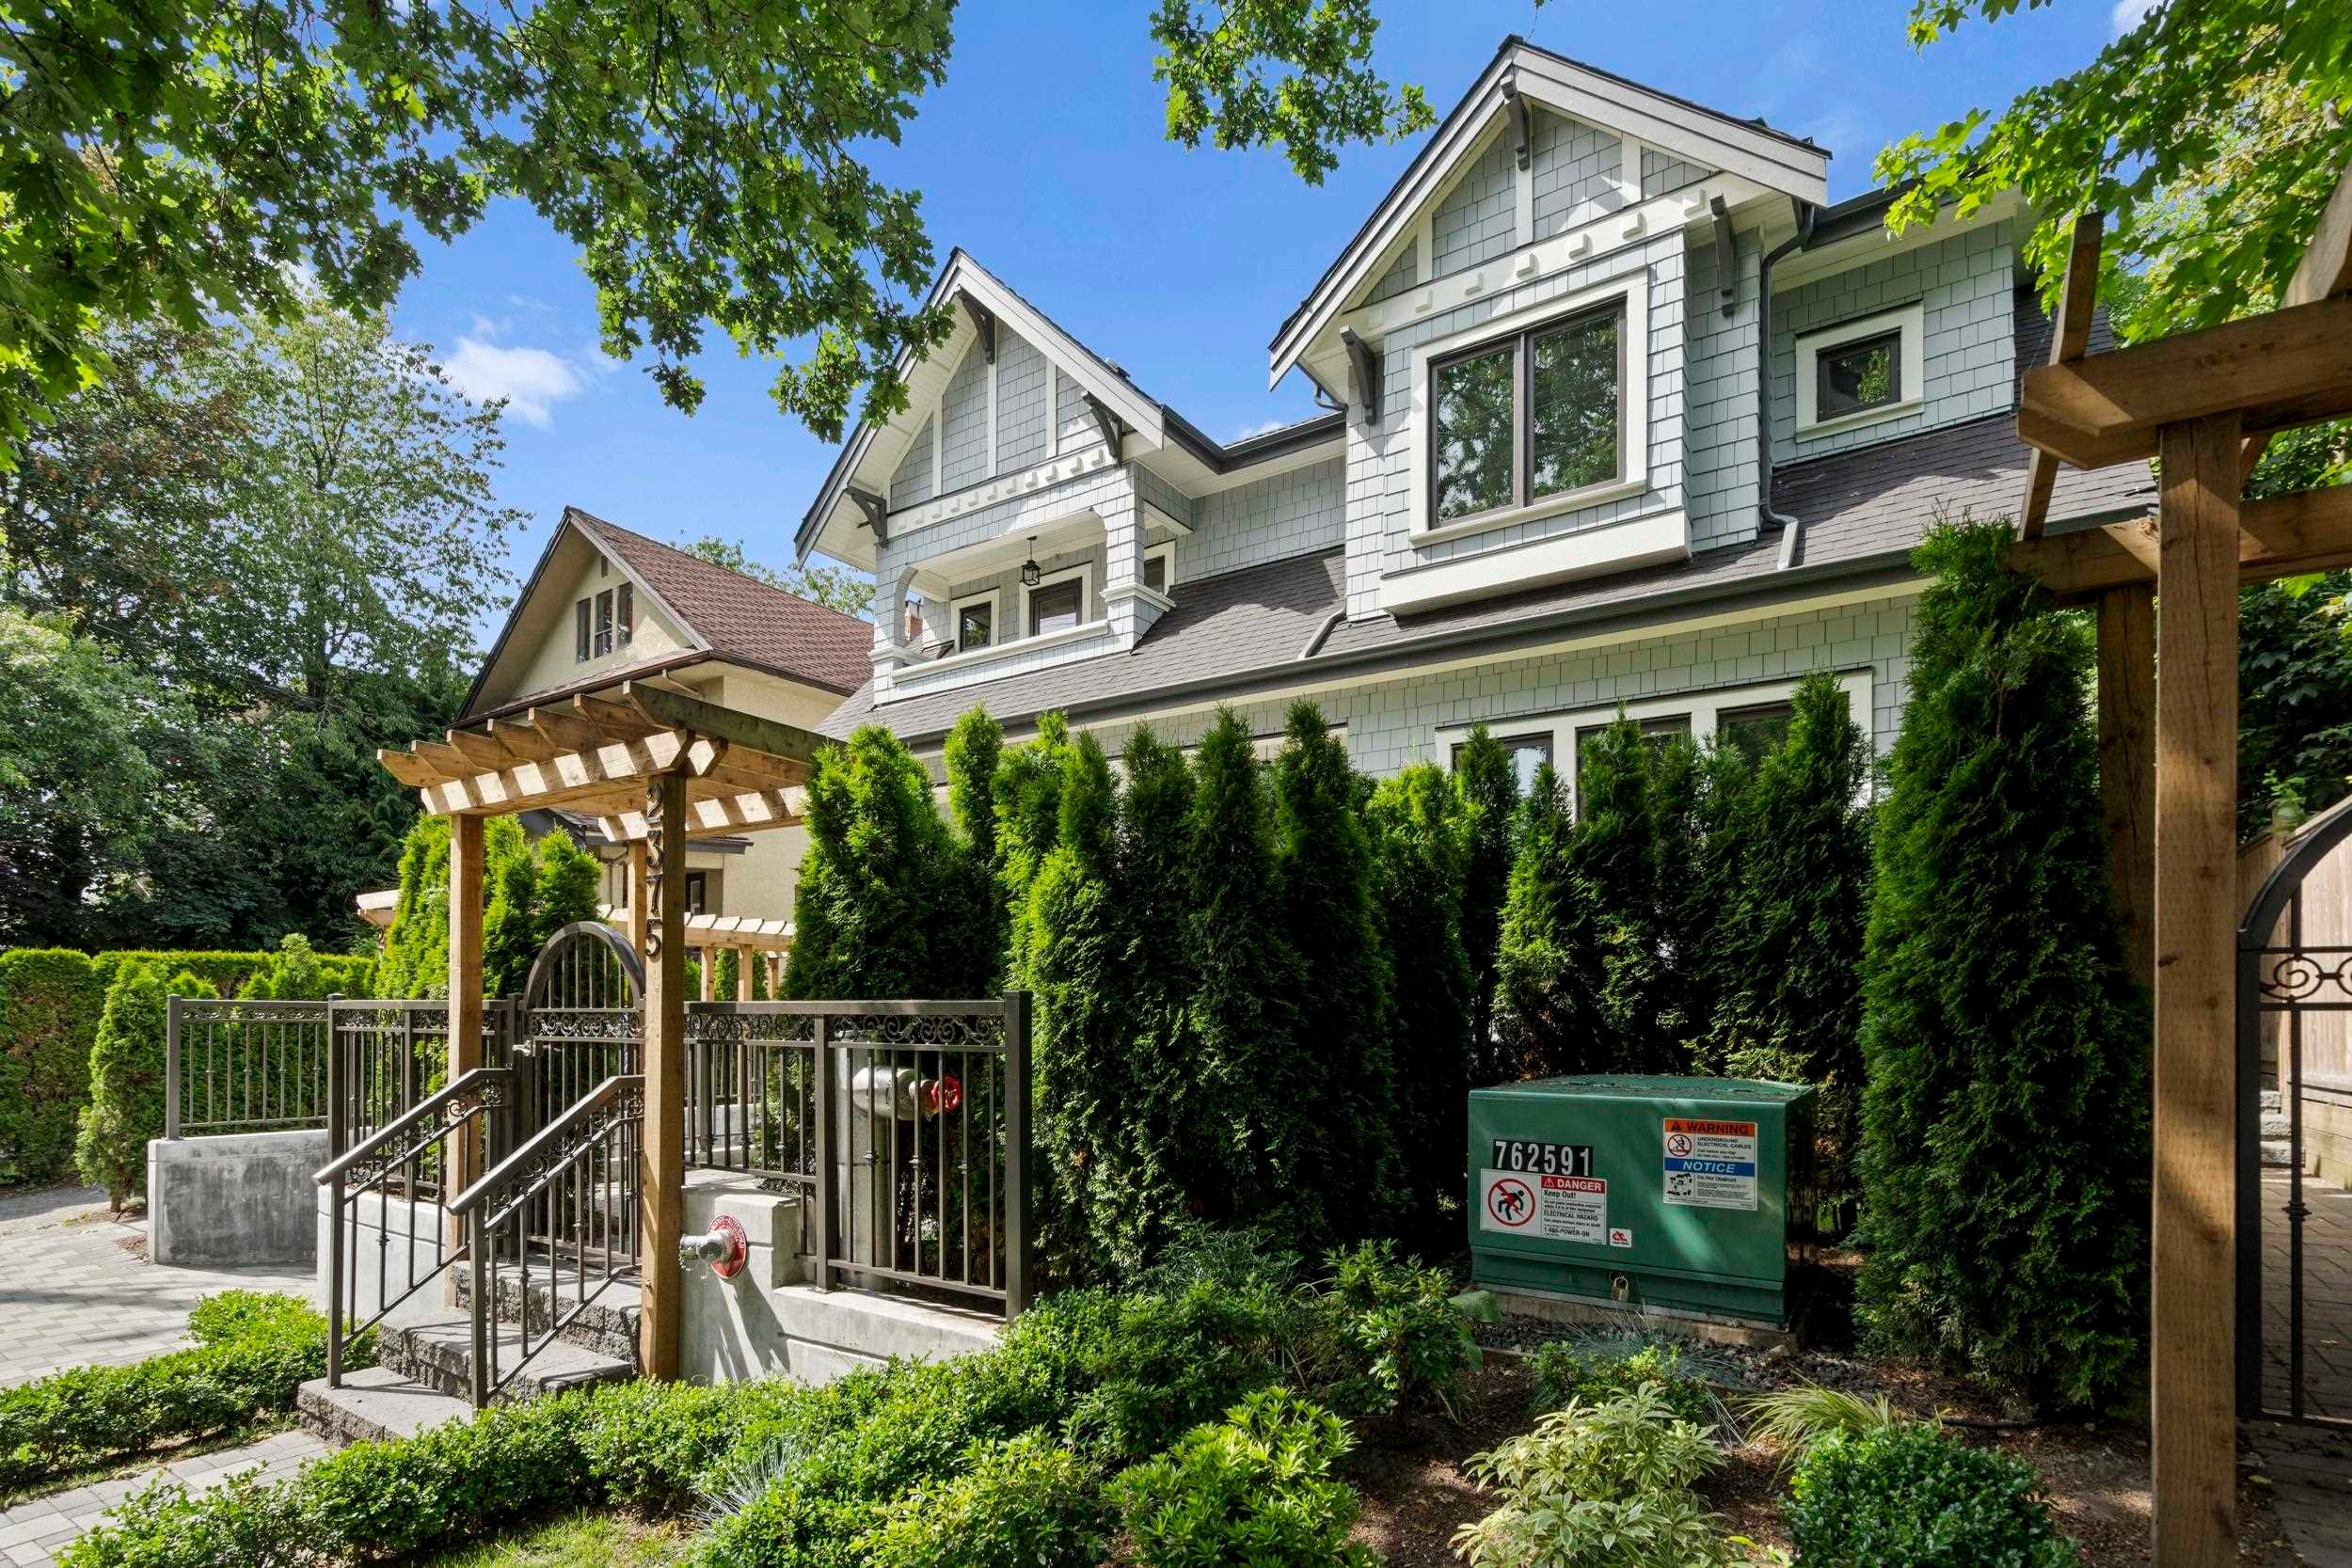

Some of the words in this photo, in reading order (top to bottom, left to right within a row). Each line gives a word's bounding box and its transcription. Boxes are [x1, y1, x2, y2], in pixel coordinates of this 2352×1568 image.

[646, 783, 663, 958] 2375
[1685, 1121, 1749, 1134] WARNING
[1495, 1140, 1590, 1177] 762591
[1682, 1161, 1737, 1173] NOTICE
[1557, 1179, 1601, 1191] DANGER
[1544, 1189, 1561, 1197] Keep
[1544, 1210, 1575, 1218] ELECTRICAL
[1576, 1213, 1598, 1222] HAZARD
